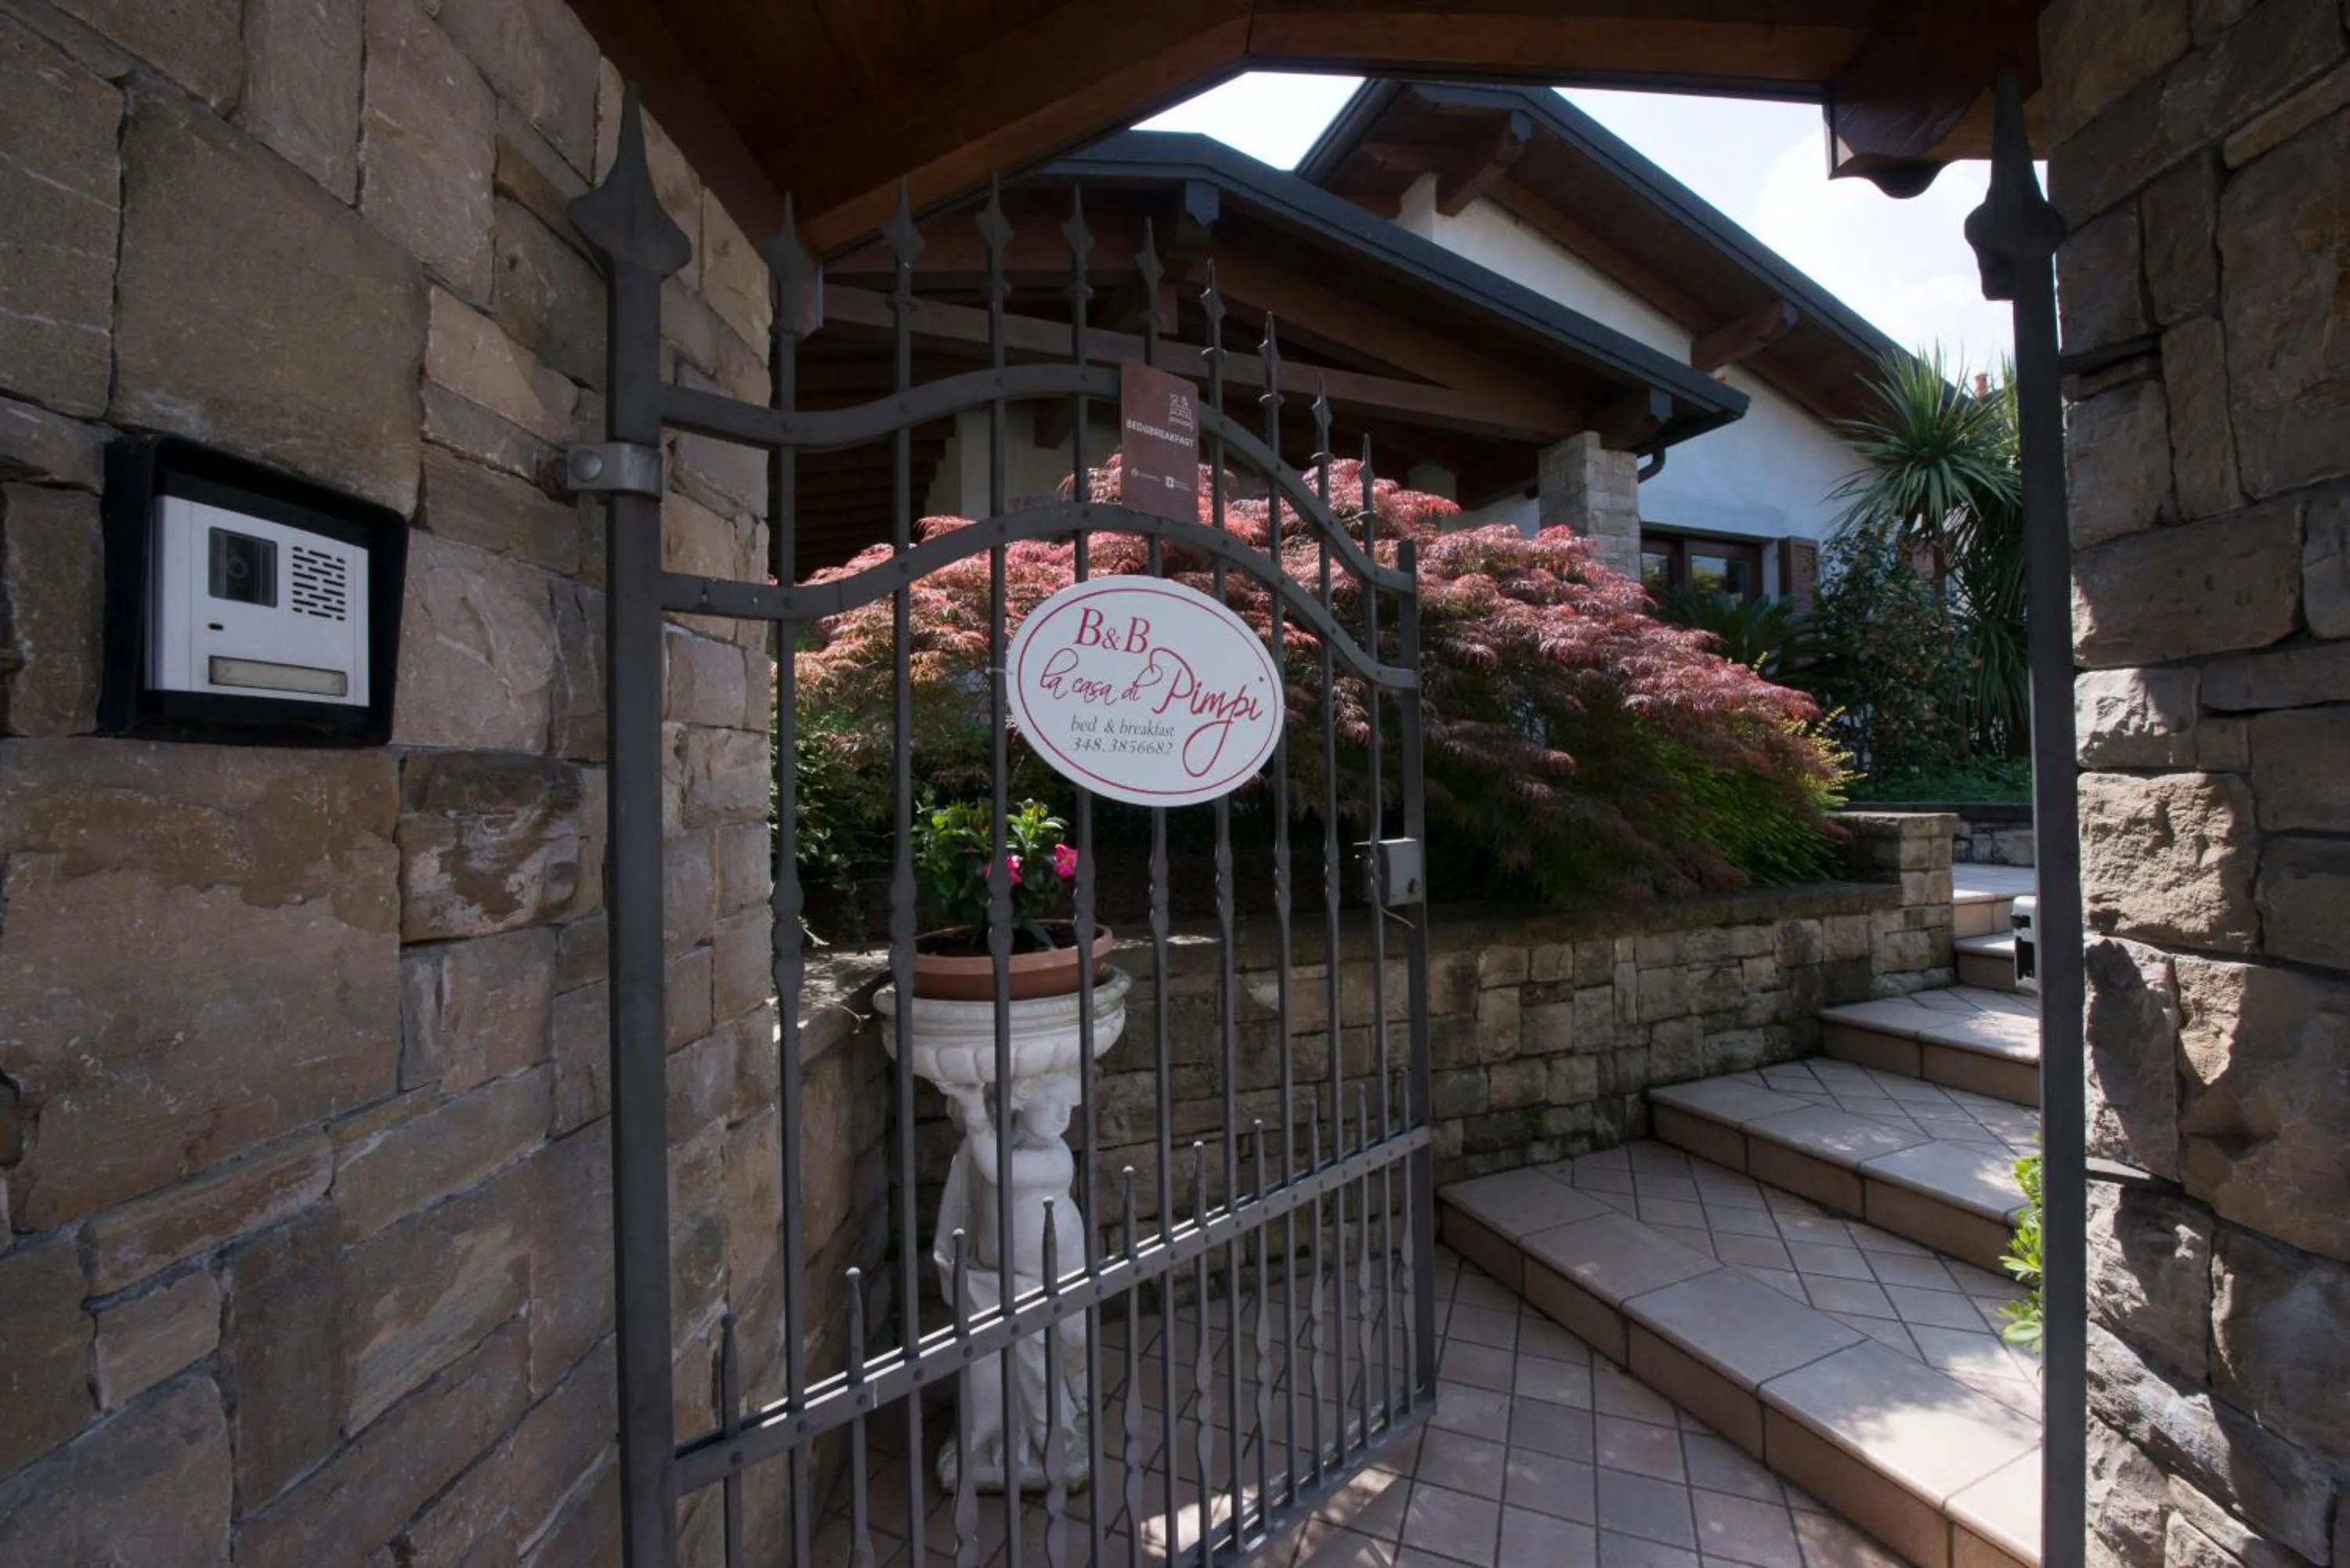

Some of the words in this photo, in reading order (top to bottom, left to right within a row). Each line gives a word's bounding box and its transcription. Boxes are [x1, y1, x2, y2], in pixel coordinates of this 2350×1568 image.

[1074, 607, 1150, 653] B&B
[1039, 648, 1079, 699] la
[1072, 675, 1116, 706] casa
[1121, 663, 1163, 701] di
[1150, 647, 1264, 777] Pimpi
[1071, 714, 1097, 732] bed
[1104, 718, 1115, 734] &
[1119, 717, 1177, 737] breakfast
